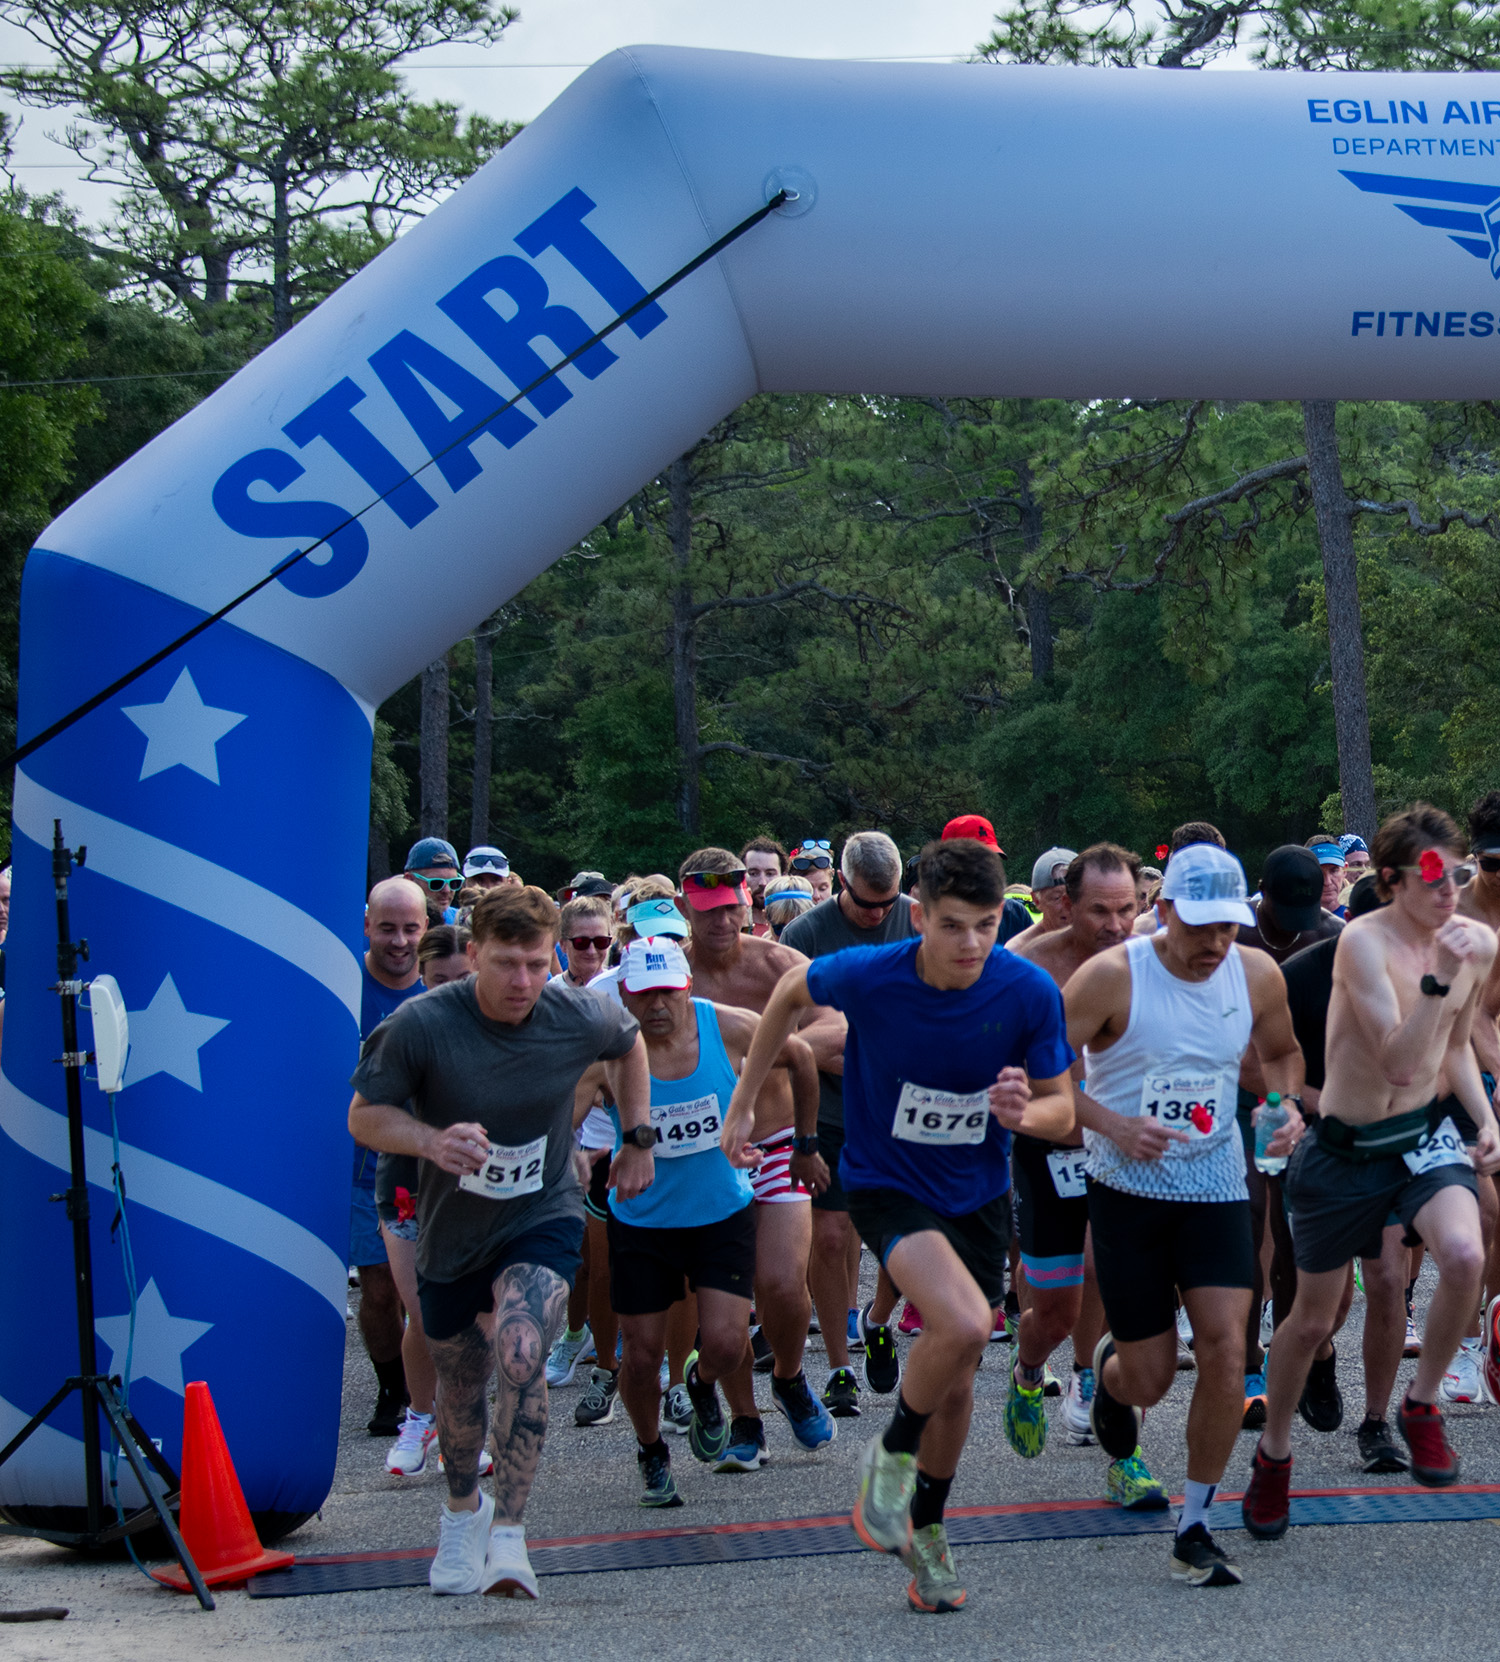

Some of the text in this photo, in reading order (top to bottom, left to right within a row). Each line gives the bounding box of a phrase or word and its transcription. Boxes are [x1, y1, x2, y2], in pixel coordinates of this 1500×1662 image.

[1307, 99, 1428, 124] EGLIN
[212, 186, 669, 599] START
[655, 1115, 719, 1144] 1493
[904, 1106, 985, 1131] 1676
[1057, 1161, 1088, 1183] 15
